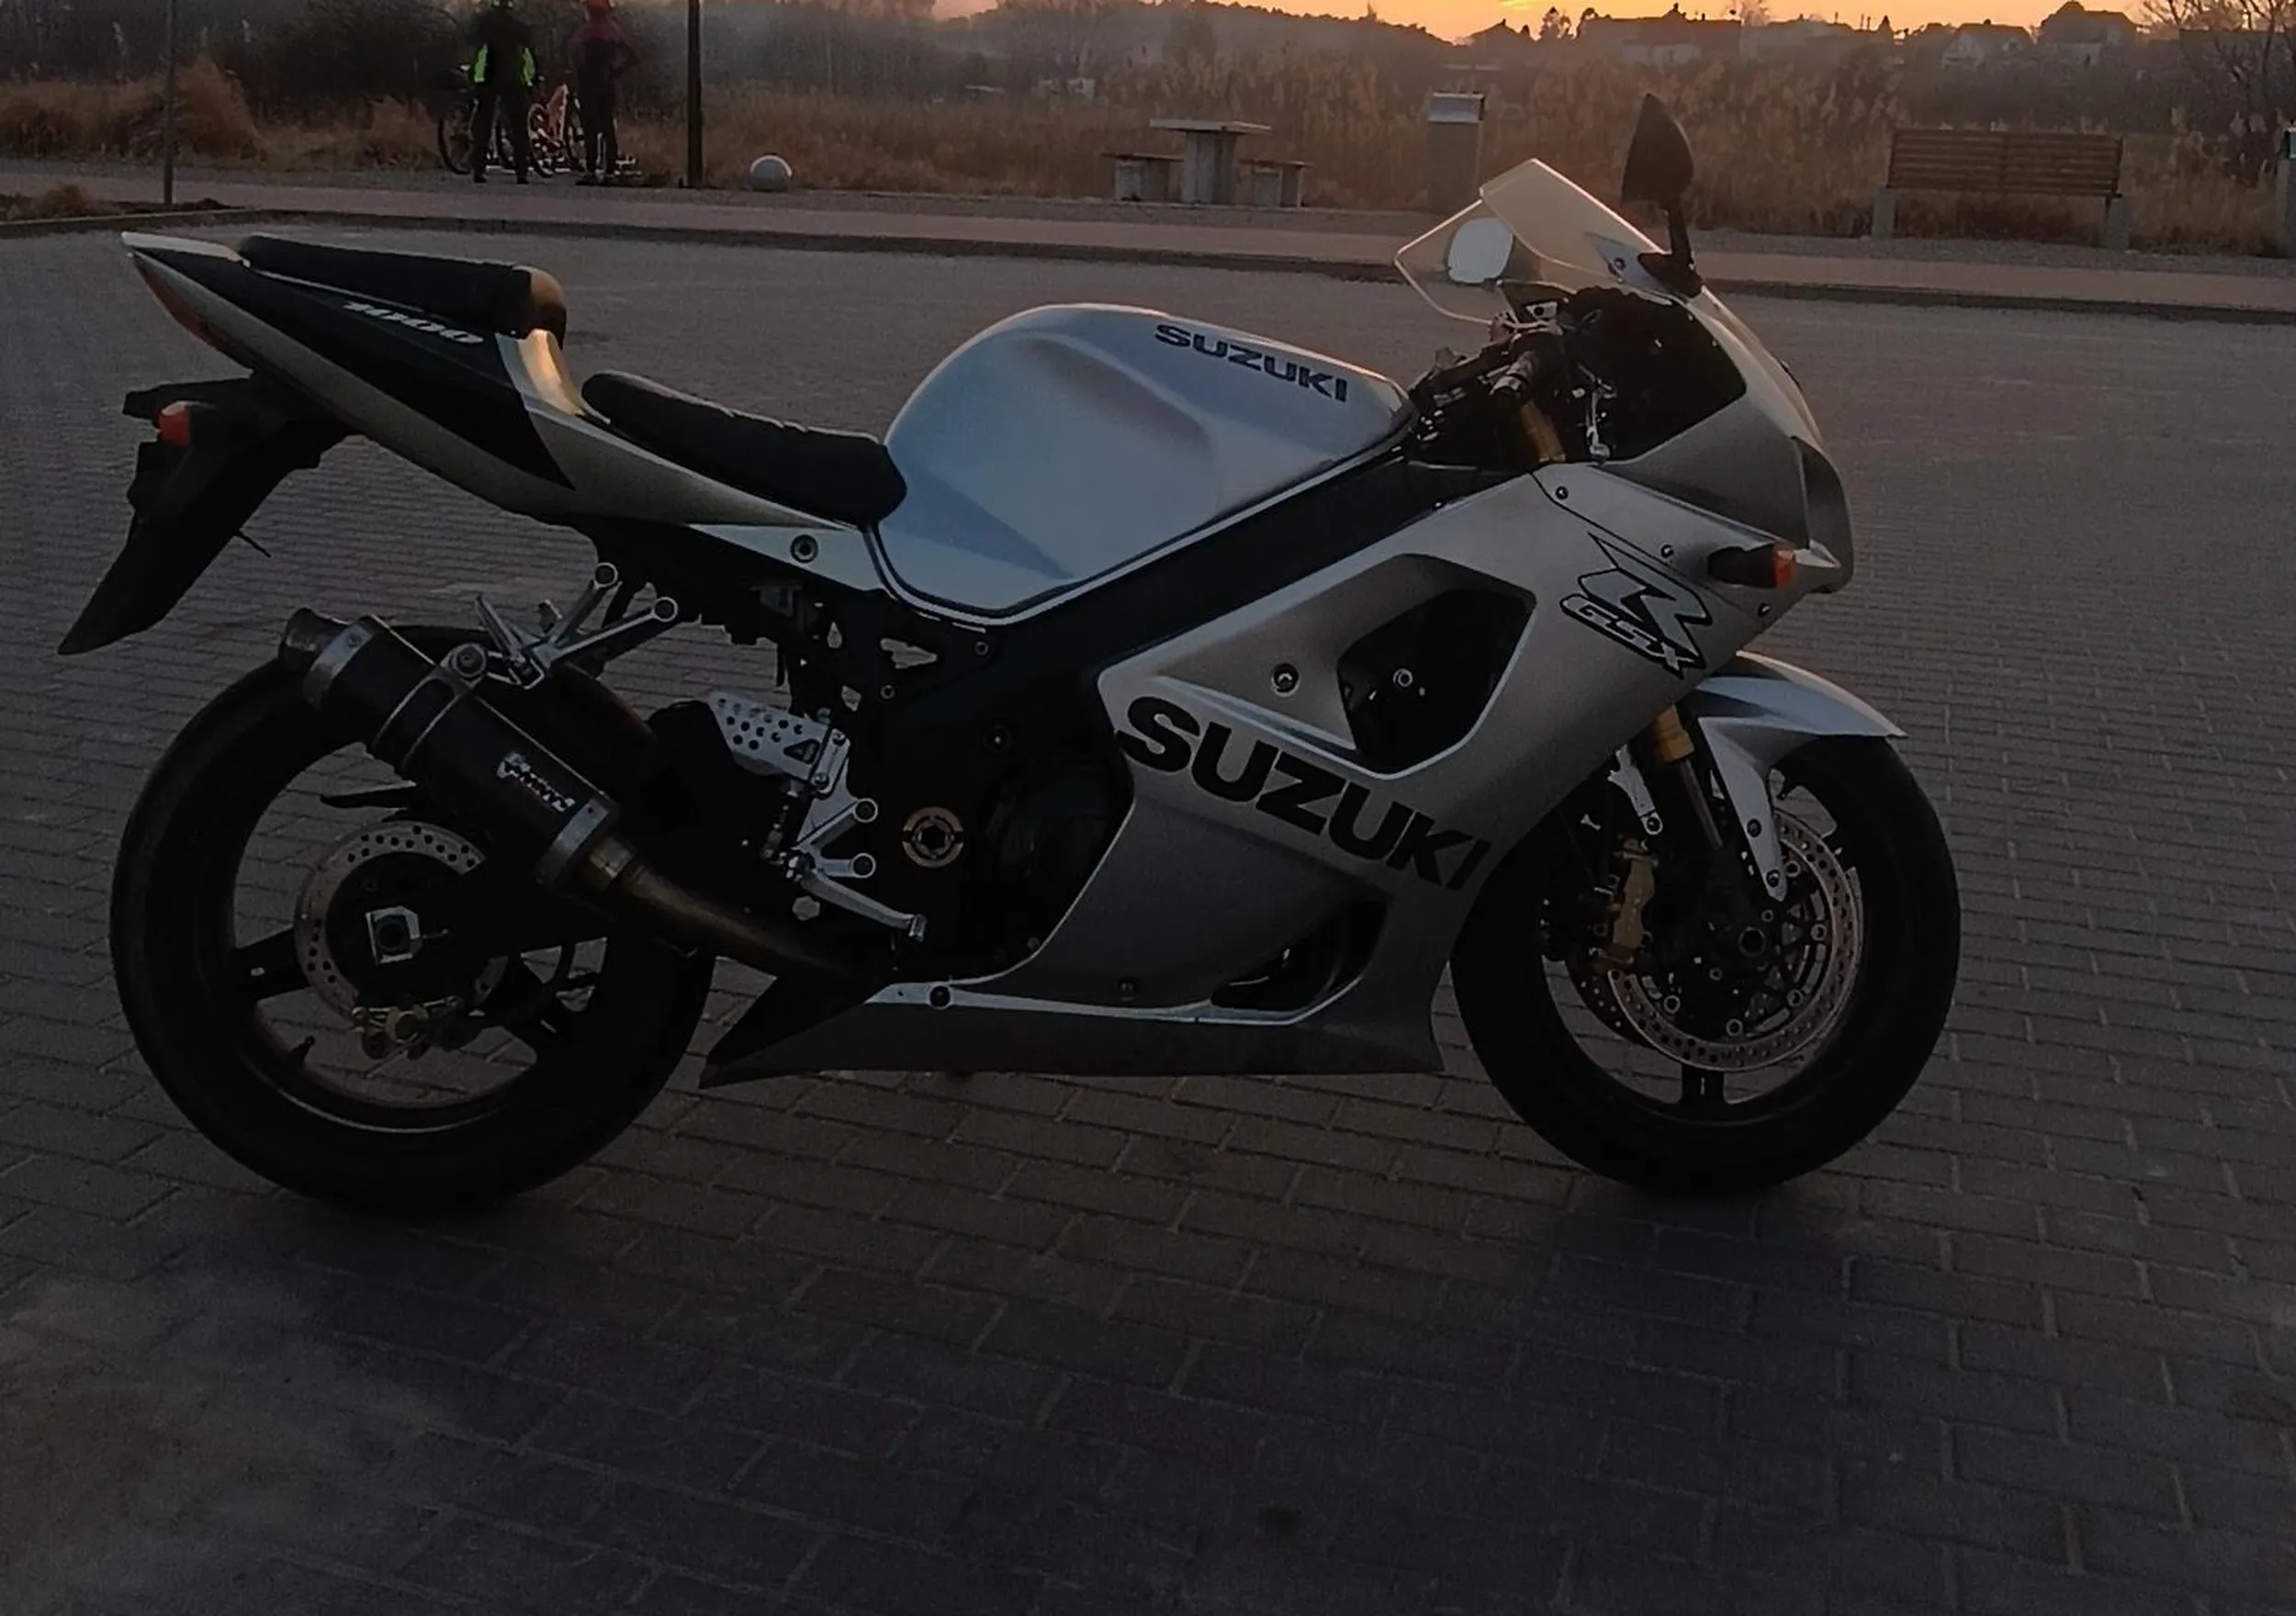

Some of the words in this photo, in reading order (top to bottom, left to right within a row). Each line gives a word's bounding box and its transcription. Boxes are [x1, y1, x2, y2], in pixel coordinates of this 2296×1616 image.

[343, 300, 485, 344] 1000
[1154, 324, 1347, 402] SUZUKI
[1118, 696, 1491, 891] SUZUKI
